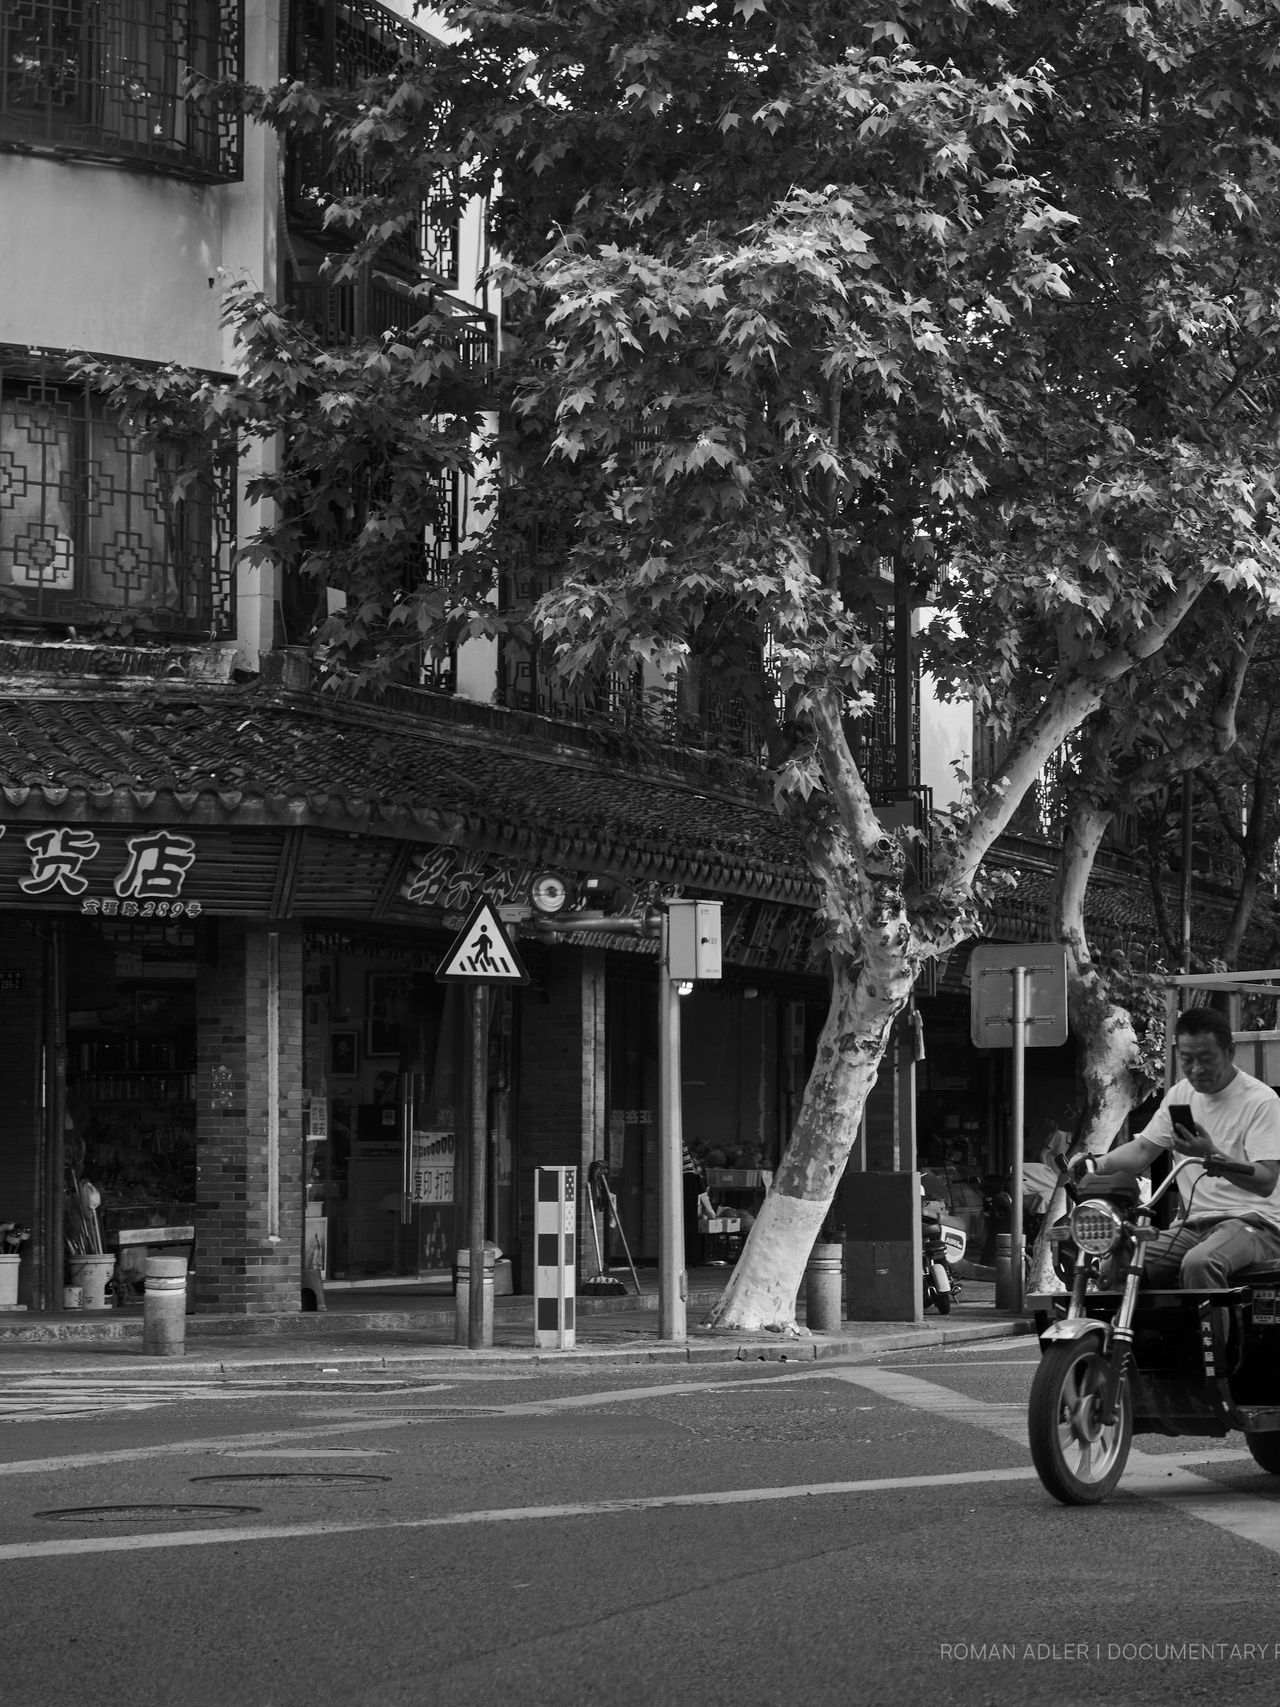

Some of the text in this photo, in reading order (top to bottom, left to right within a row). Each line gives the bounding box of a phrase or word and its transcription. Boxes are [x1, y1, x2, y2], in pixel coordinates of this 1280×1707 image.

[0, 825, 195, 898] 货店
[81, 899, 203, 918] 宏福路289号
